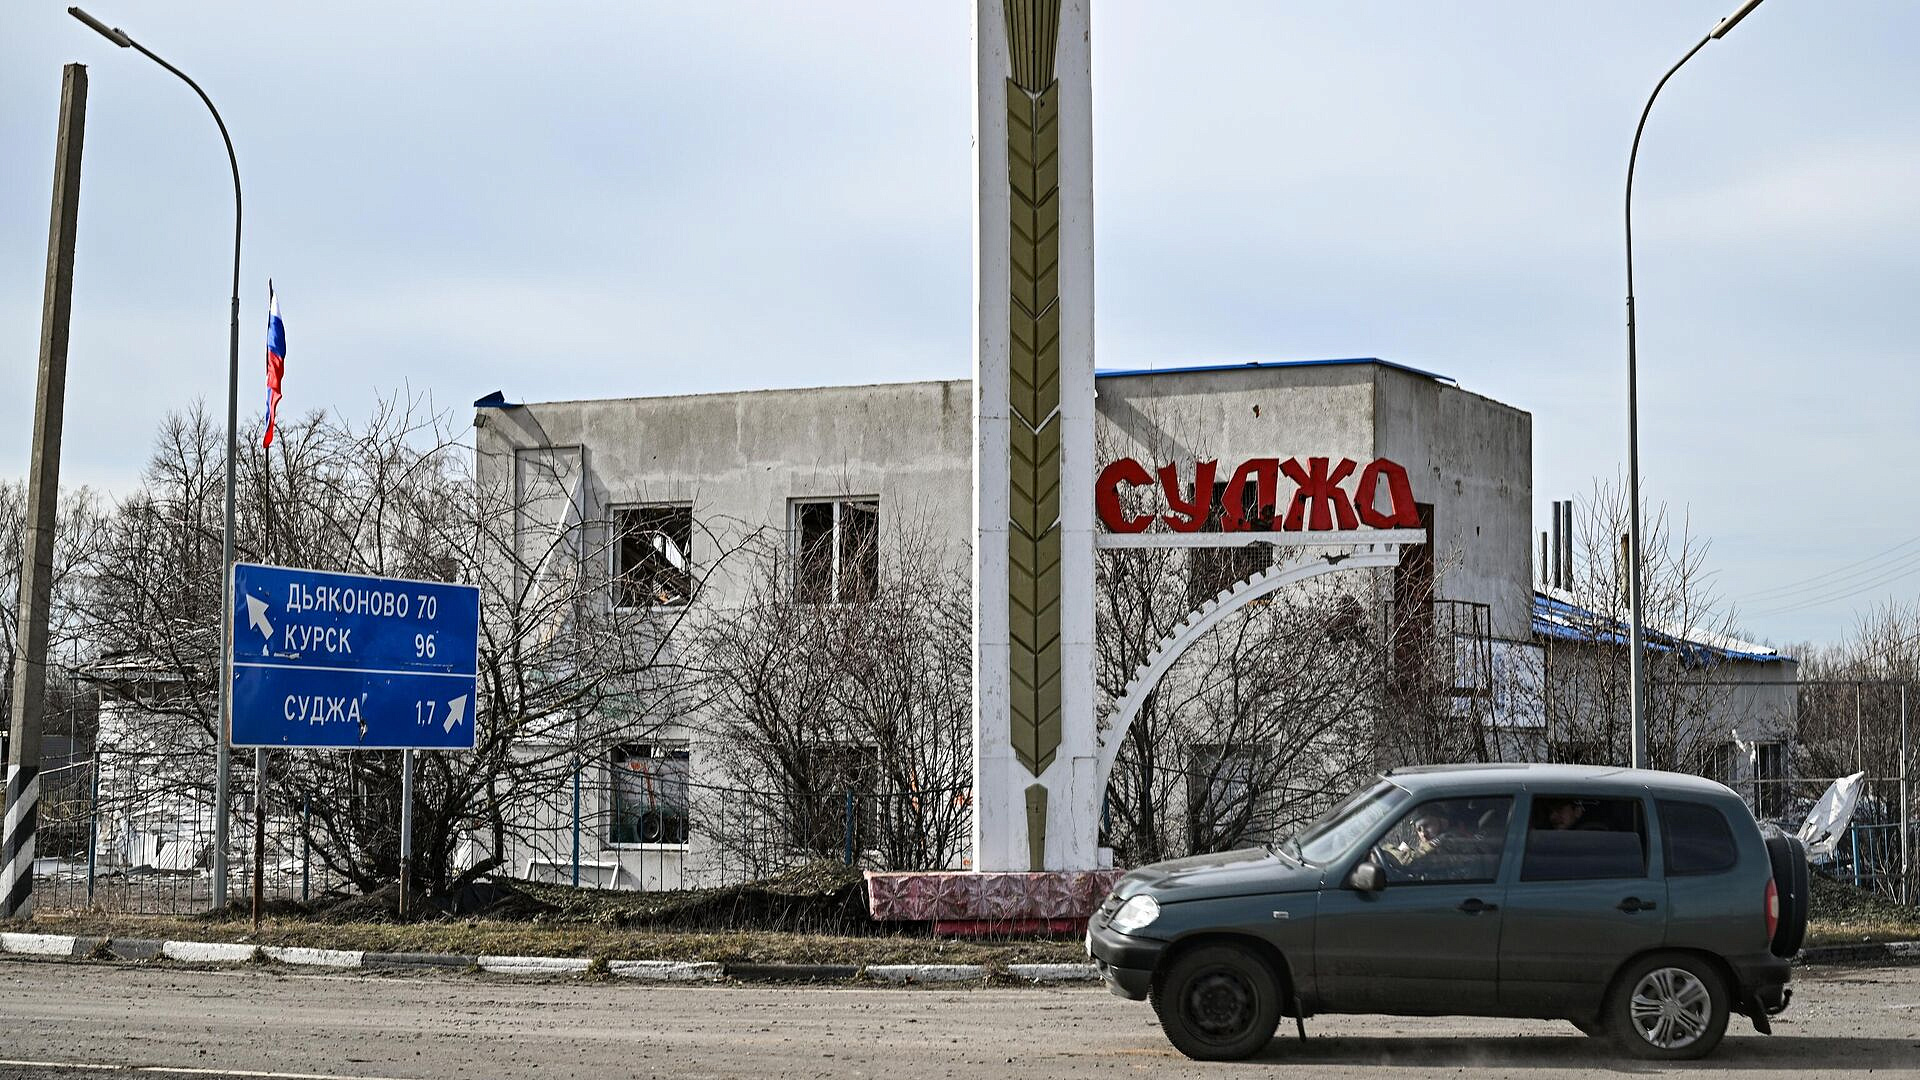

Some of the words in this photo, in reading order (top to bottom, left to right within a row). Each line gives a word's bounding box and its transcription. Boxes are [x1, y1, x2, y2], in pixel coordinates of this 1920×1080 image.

[1095, 458, 1421, 533] СУДЖА
[286, 583, 409, 618] ДЬЯКОНОВО
[416, 595, 437, 620] 70
[284, 624, 352, 654] КУРСК
[414, 634, 436, 658] 96
[284, 695, 361, 726] СУДЖА
